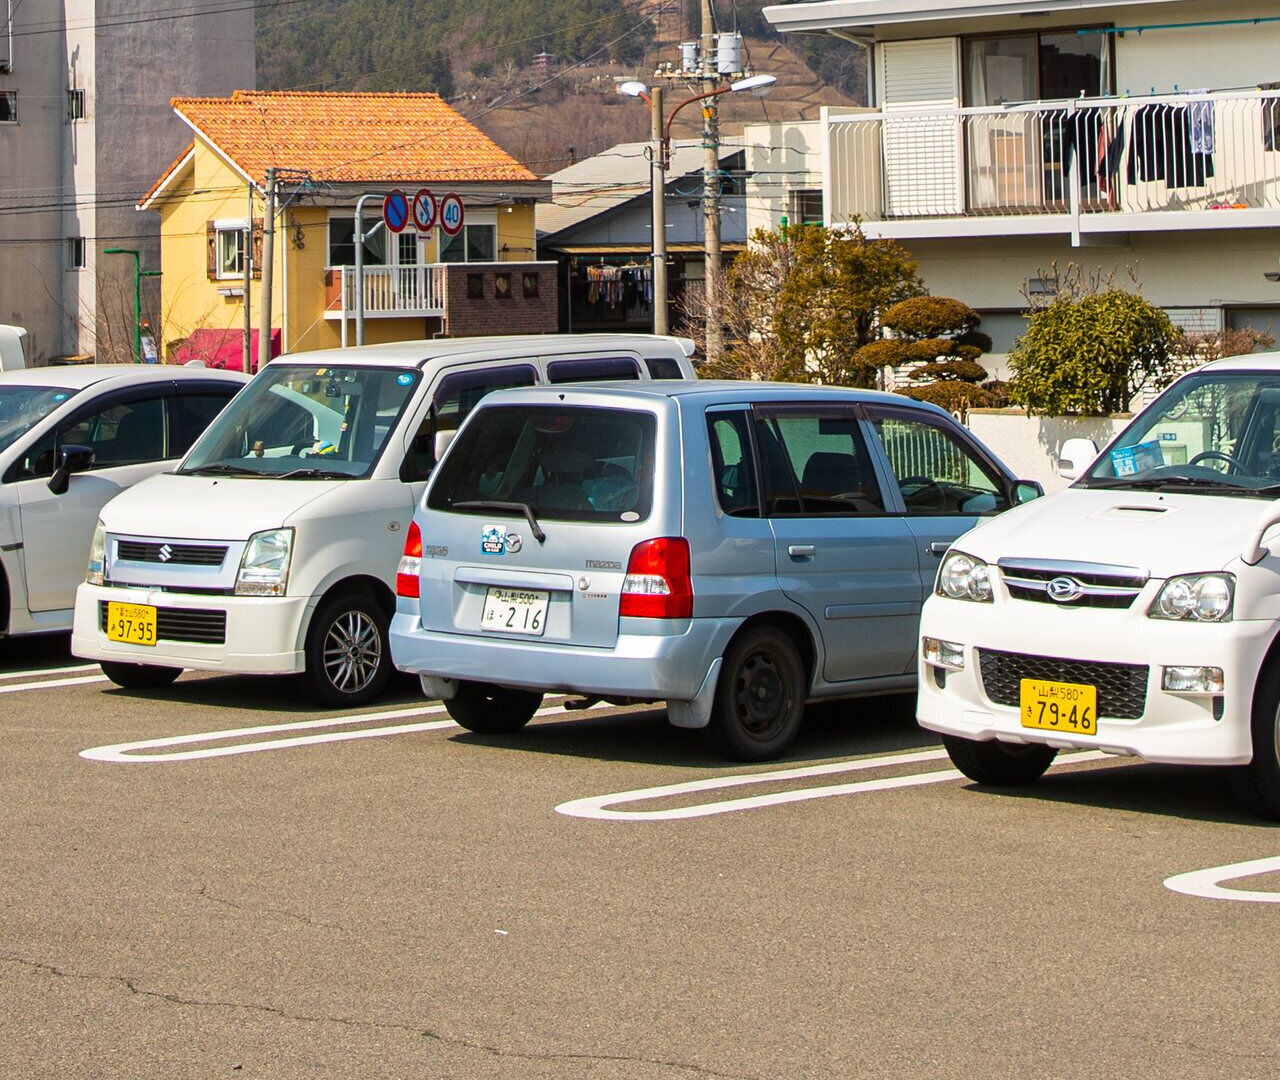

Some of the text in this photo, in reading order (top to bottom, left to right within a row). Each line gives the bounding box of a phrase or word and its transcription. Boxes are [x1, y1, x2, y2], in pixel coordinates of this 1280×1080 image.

[445, 204, 459, 223] 40
[118, 619, 153, 642] 97-95
[1037, 700, 1091, 730] 79-46
